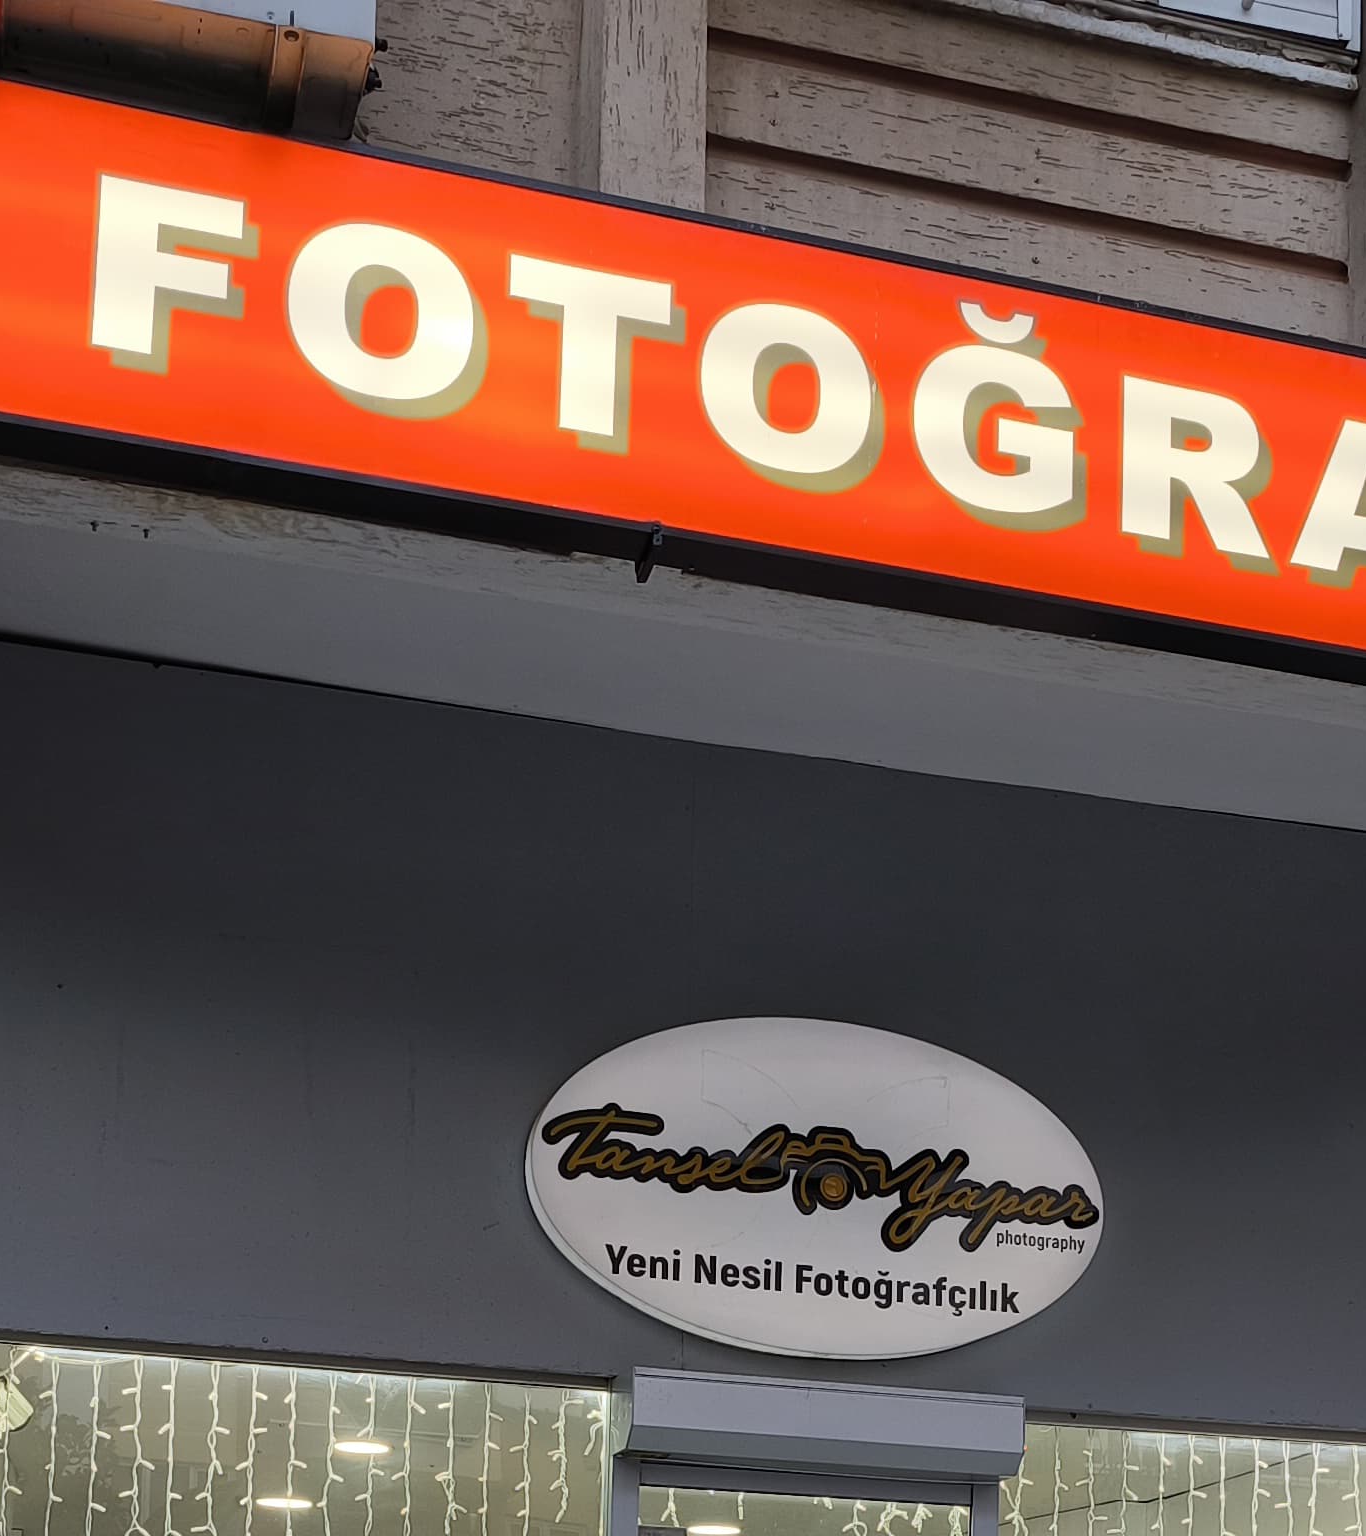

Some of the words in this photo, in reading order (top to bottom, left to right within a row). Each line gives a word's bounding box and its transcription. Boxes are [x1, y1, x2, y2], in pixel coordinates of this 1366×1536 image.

[542, 1103, 791, 1194] Tansel
[880, 1149, 1099, 1252] Yapar
[996, 1230, 1086, 1255] photography
[605, 1243, 682, 1283] Yeni
[694, 1254, 783, 1293] Nesil
[795, 1264, 1020, 1317] Fotoğrafçılık
